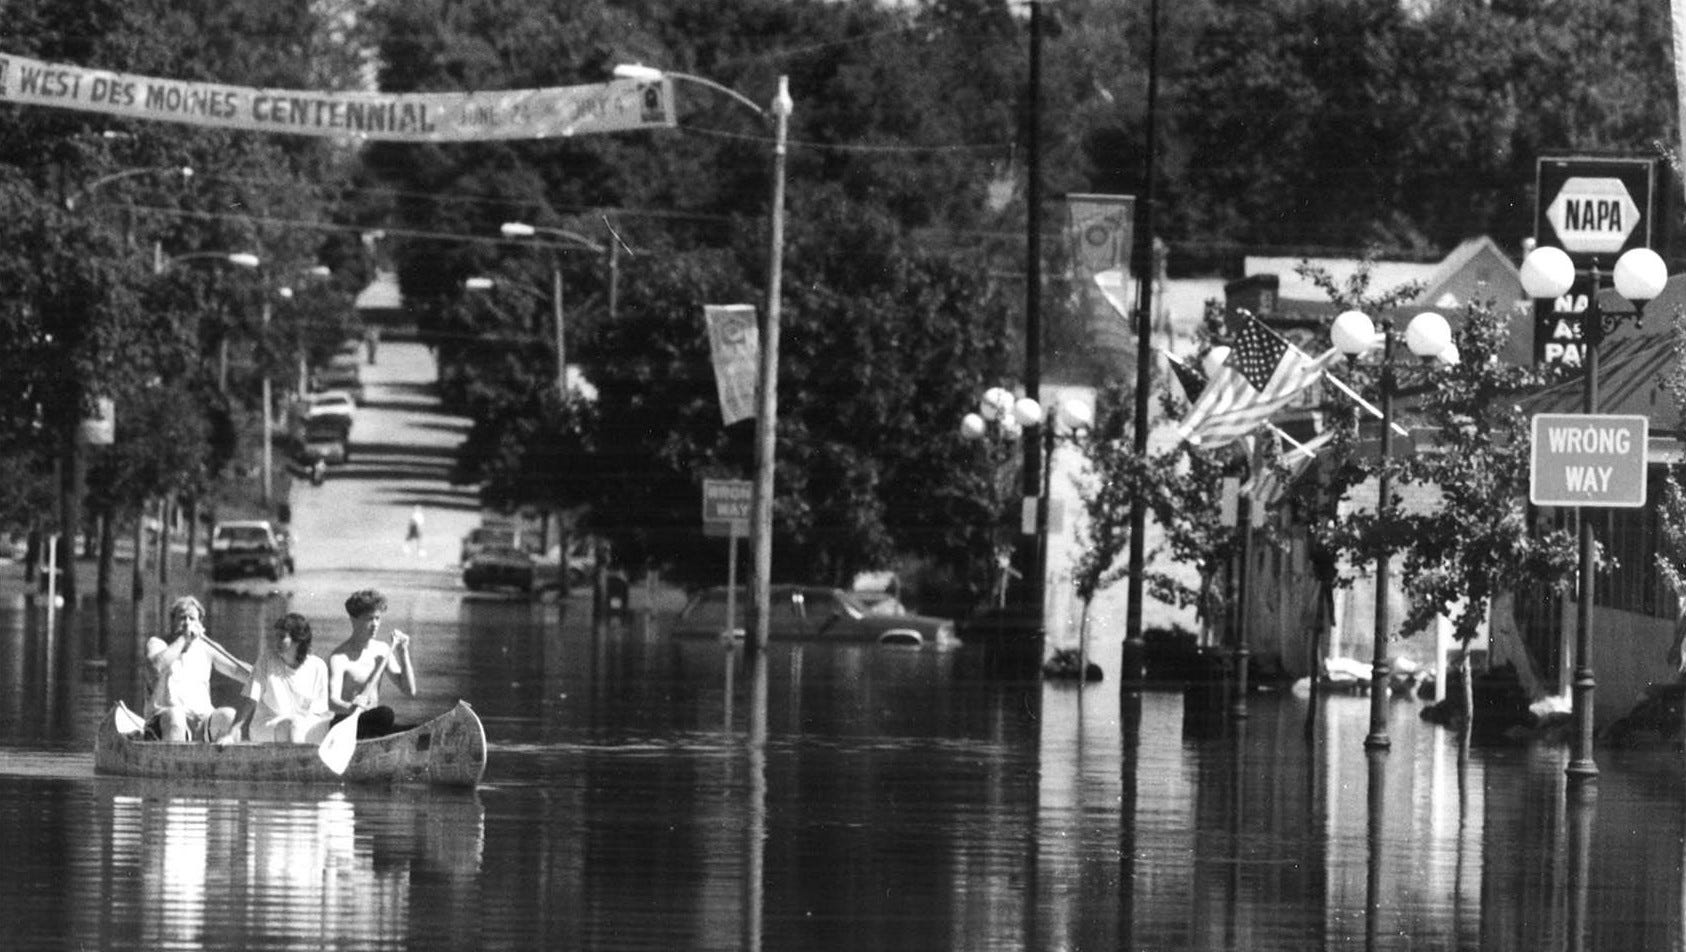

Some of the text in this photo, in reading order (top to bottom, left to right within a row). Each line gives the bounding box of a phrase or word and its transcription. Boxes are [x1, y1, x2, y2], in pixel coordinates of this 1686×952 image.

[20, 64, 83, 99] WEST
[90, 76, 136, 106] DES
[144, 84, 238, 119] MOINES
[252, 96, 435, 132] CENTENNIAL
[1564, 199, 1622, 232] NAPA
[1554, 294, 1590, 313] NA
[1547, 425, 1632, 455] WRONG
[707, 485, 753, 500] WRON
[1564, 464, 1614, 493] WAY
[716, 502, 750, 517] WAY
